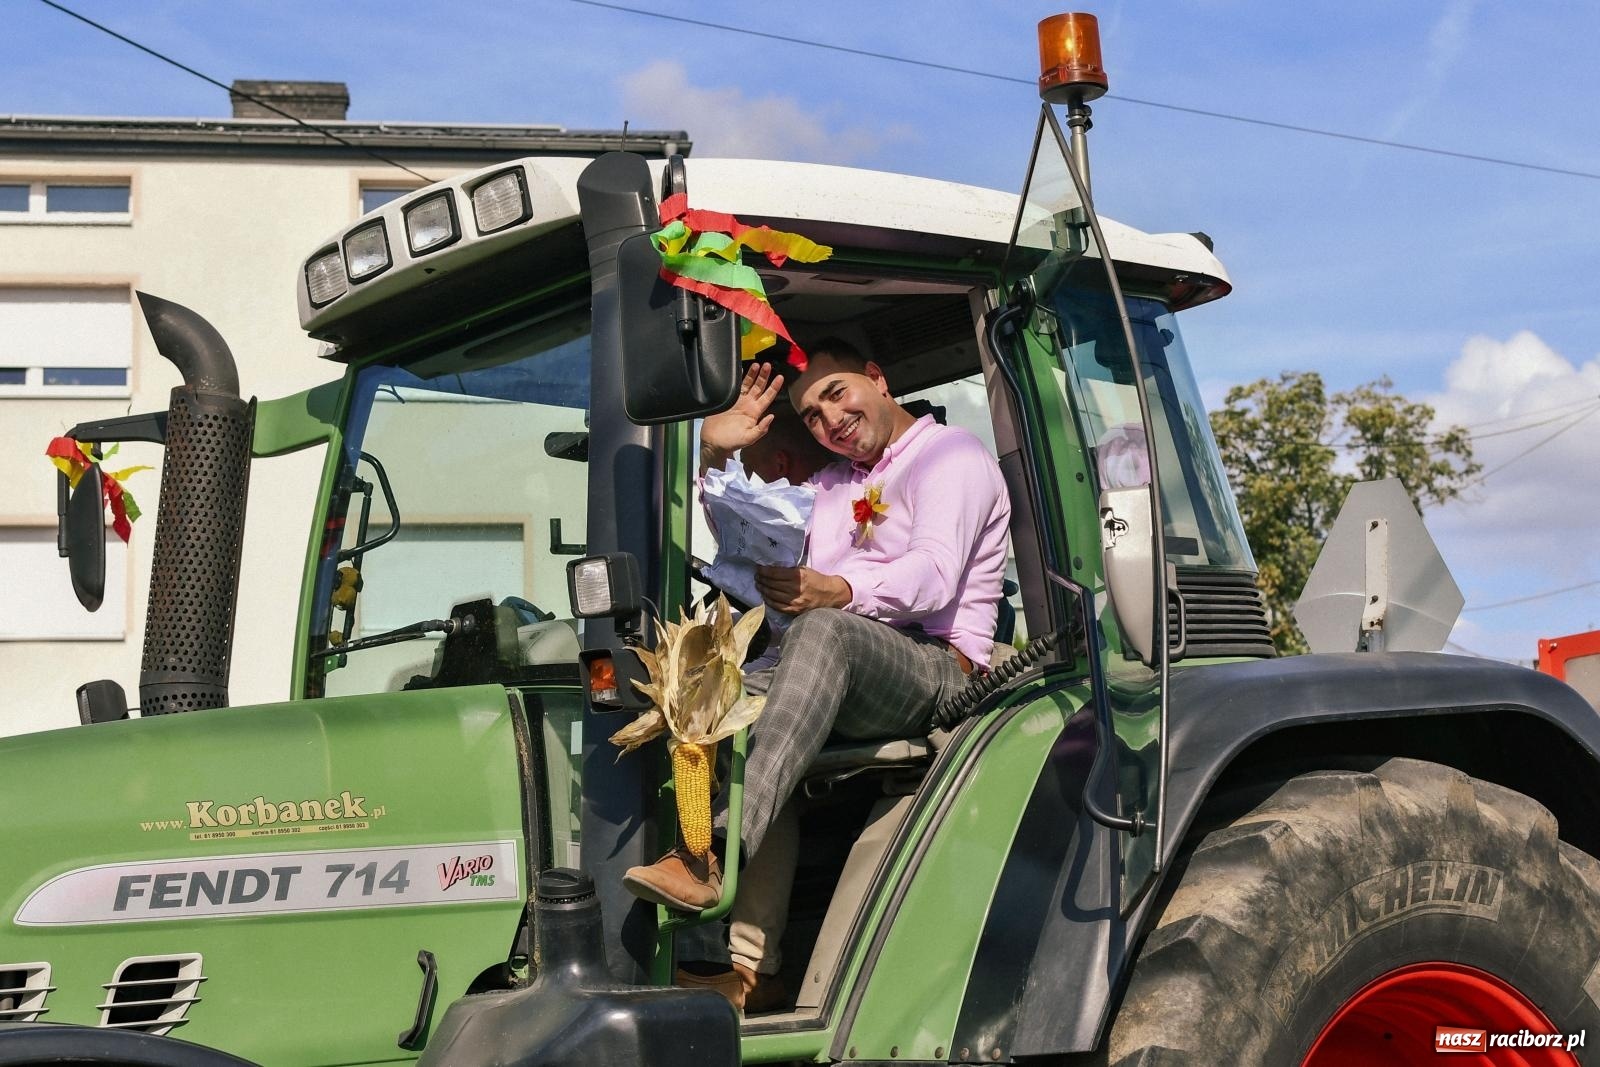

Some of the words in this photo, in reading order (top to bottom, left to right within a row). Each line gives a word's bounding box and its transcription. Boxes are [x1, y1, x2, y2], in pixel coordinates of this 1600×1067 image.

[113, 866, 302, 911] FENDT
[325, 859, 410, 899] 714
[437, 855, 493, 891] VARIO
[469, 874, 496, 887] TMS
